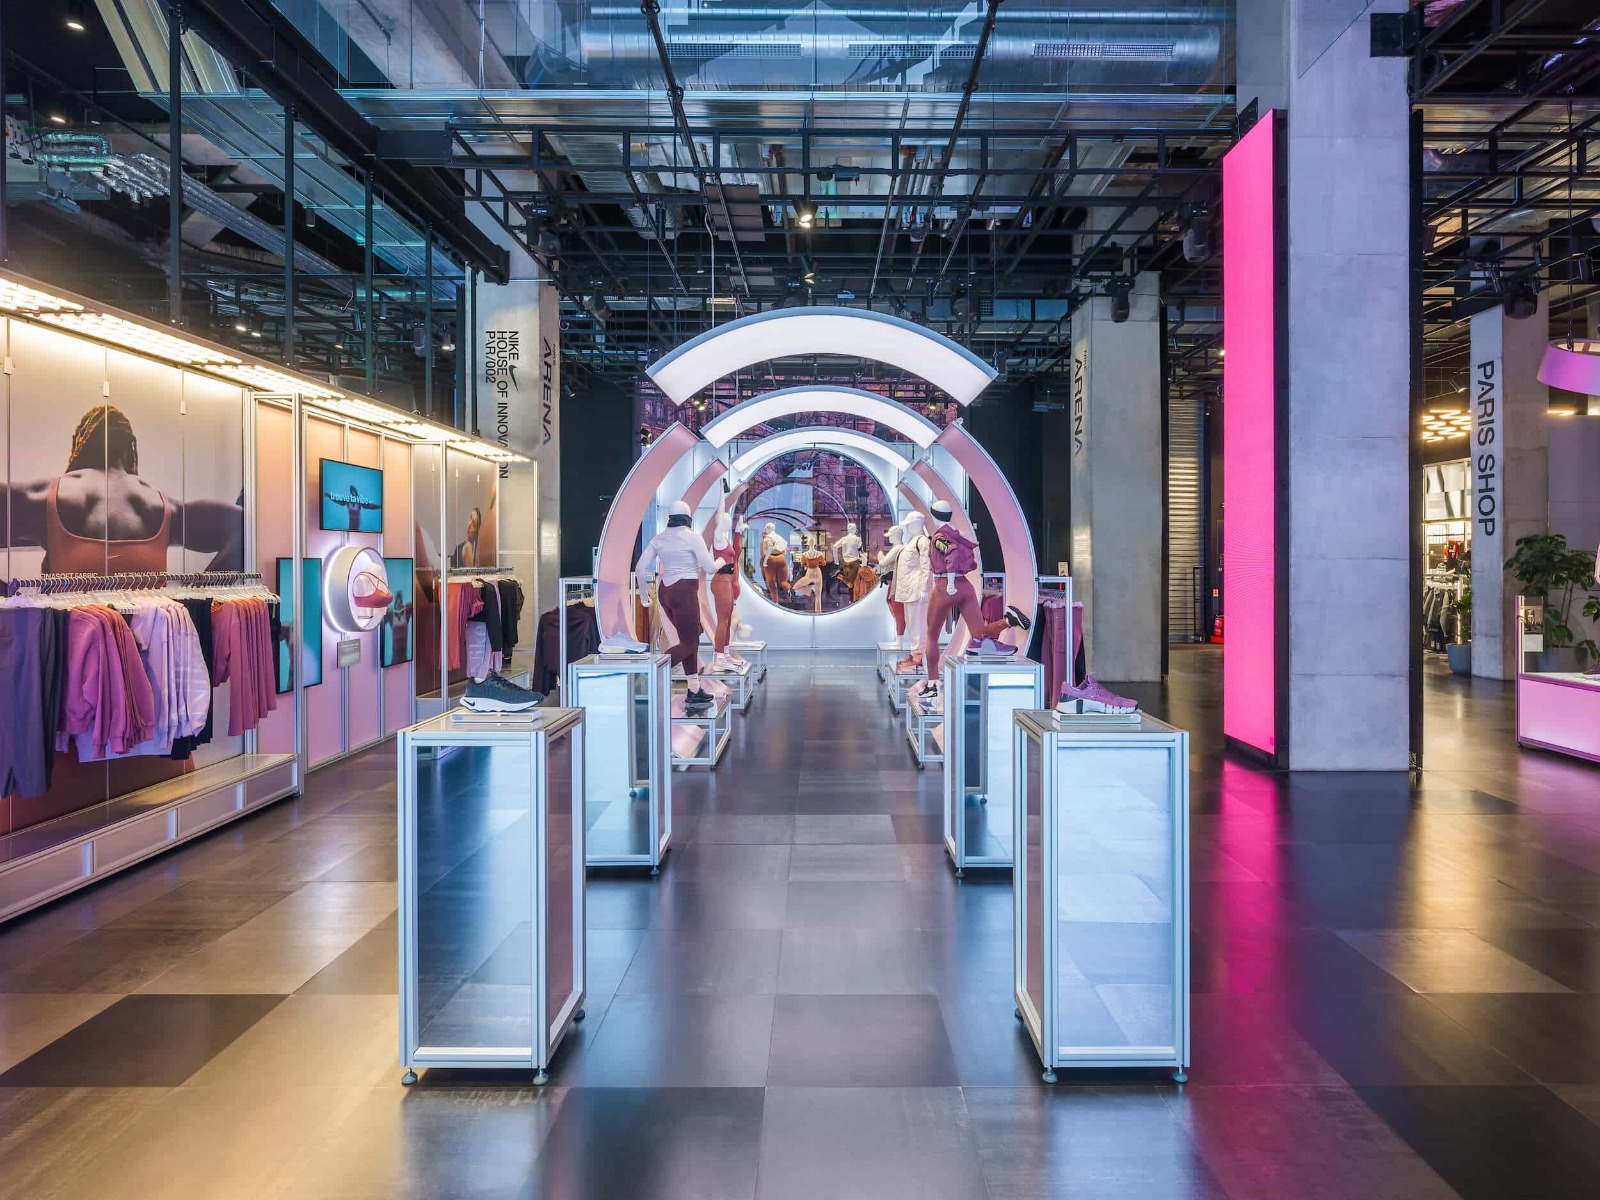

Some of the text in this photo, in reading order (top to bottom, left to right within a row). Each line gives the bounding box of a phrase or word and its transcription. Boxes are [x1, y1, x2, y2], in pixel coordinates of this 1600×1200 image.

[485, 331, 496, 384] PAR/002
[508, 331, 519, 360] NIKE
[543, 336, 552, 445] ARENA
[497, 331, 509, 479] HOUSE OF INNOVAON
[1074, 358, 1083, 457] ARENA
[1477, 360, 1496, 536] PARIS SHOP
